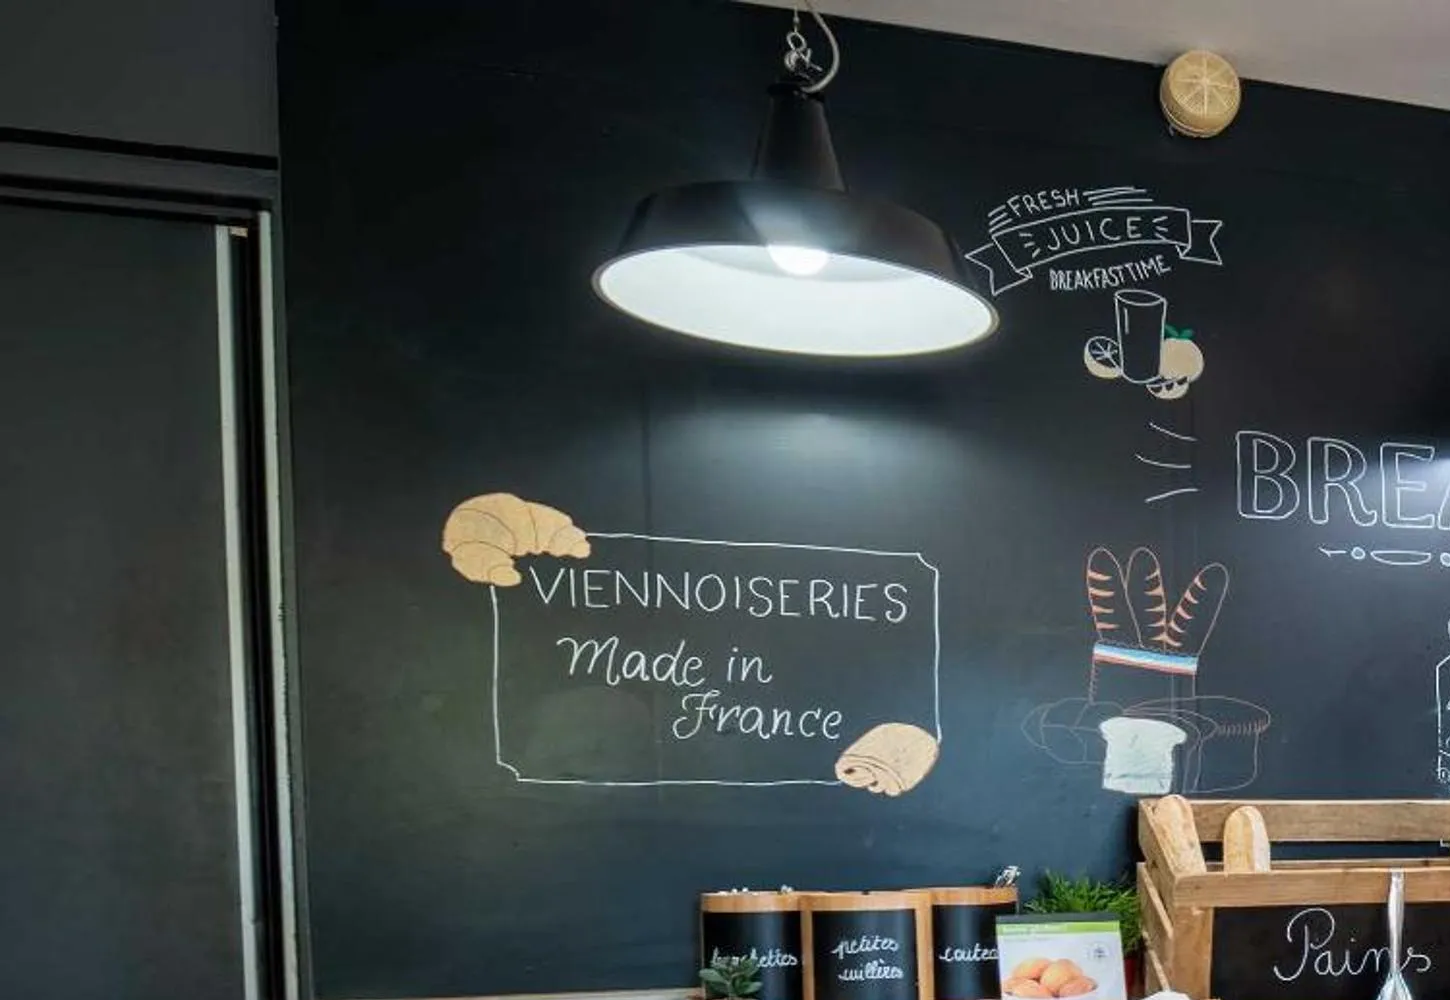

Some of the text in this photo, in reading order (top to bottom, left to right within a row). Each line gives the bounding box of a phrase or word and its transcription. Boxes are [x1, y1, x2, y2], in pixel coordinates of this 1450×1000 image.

[1007, 189, 1080, 218] FRESH
[1047, 216, 1142, 250] JUICE
[529, 566, 909, 623] VIENNOISERIES
[556, 635, 773, 686] Made in
[672, 689, 843, 739] France
[1273, 908, 1432, 981] Pains
